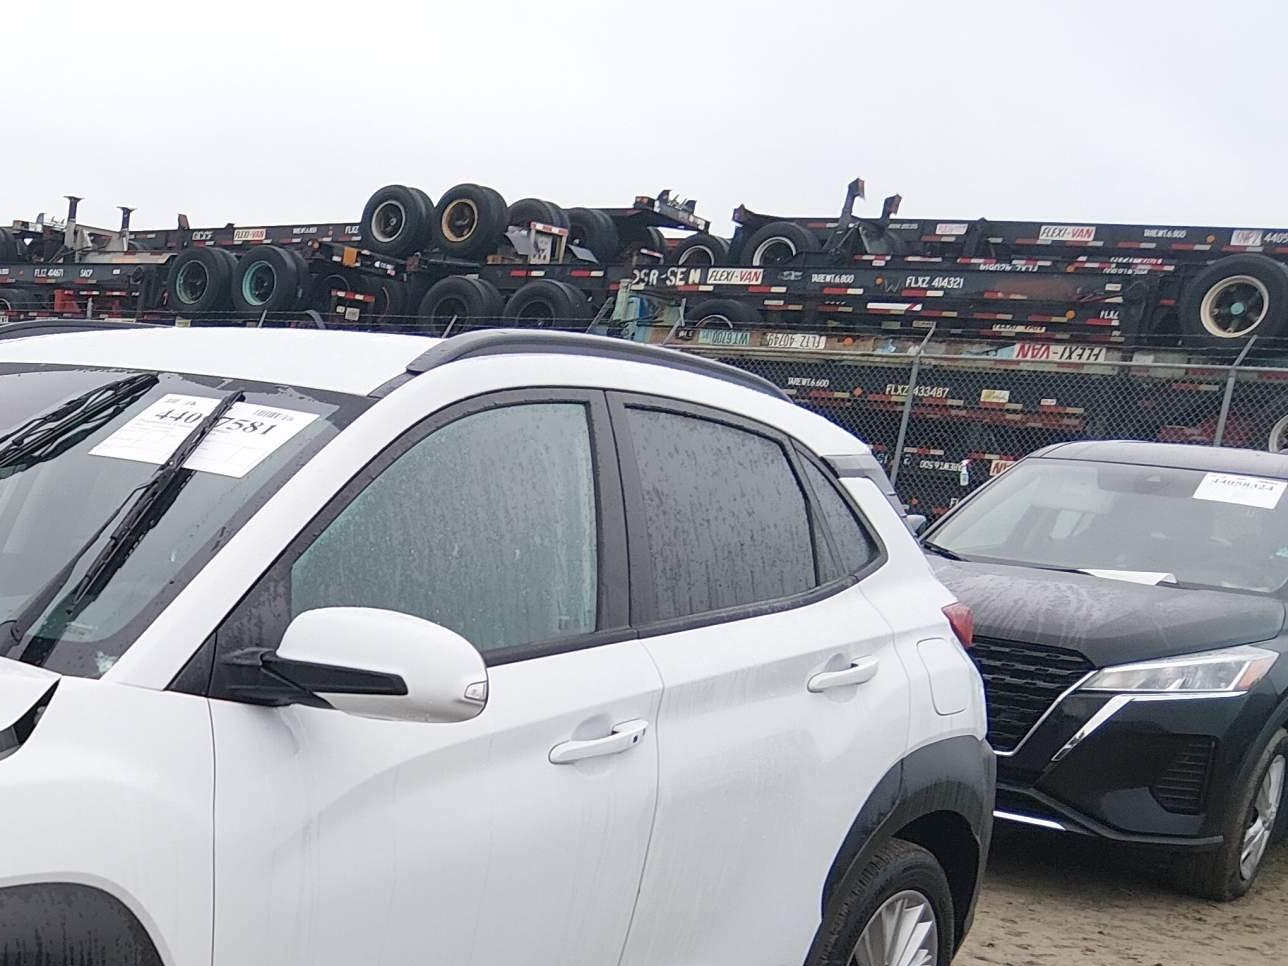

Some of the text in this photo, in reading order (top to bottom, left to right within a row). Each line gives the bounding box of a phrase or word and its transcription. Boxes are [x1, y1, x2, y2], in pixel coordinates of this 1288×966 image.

[1040, 226, 1093, 240] FLEXI-VAN
[709, 271, 761, 284] FLEXI-VAN
[905, 277, 964, 289] FLXZ 414321
[885, 384, 950, 398] FLXZ 433487
[154, 407, 278, 436] 4407581
